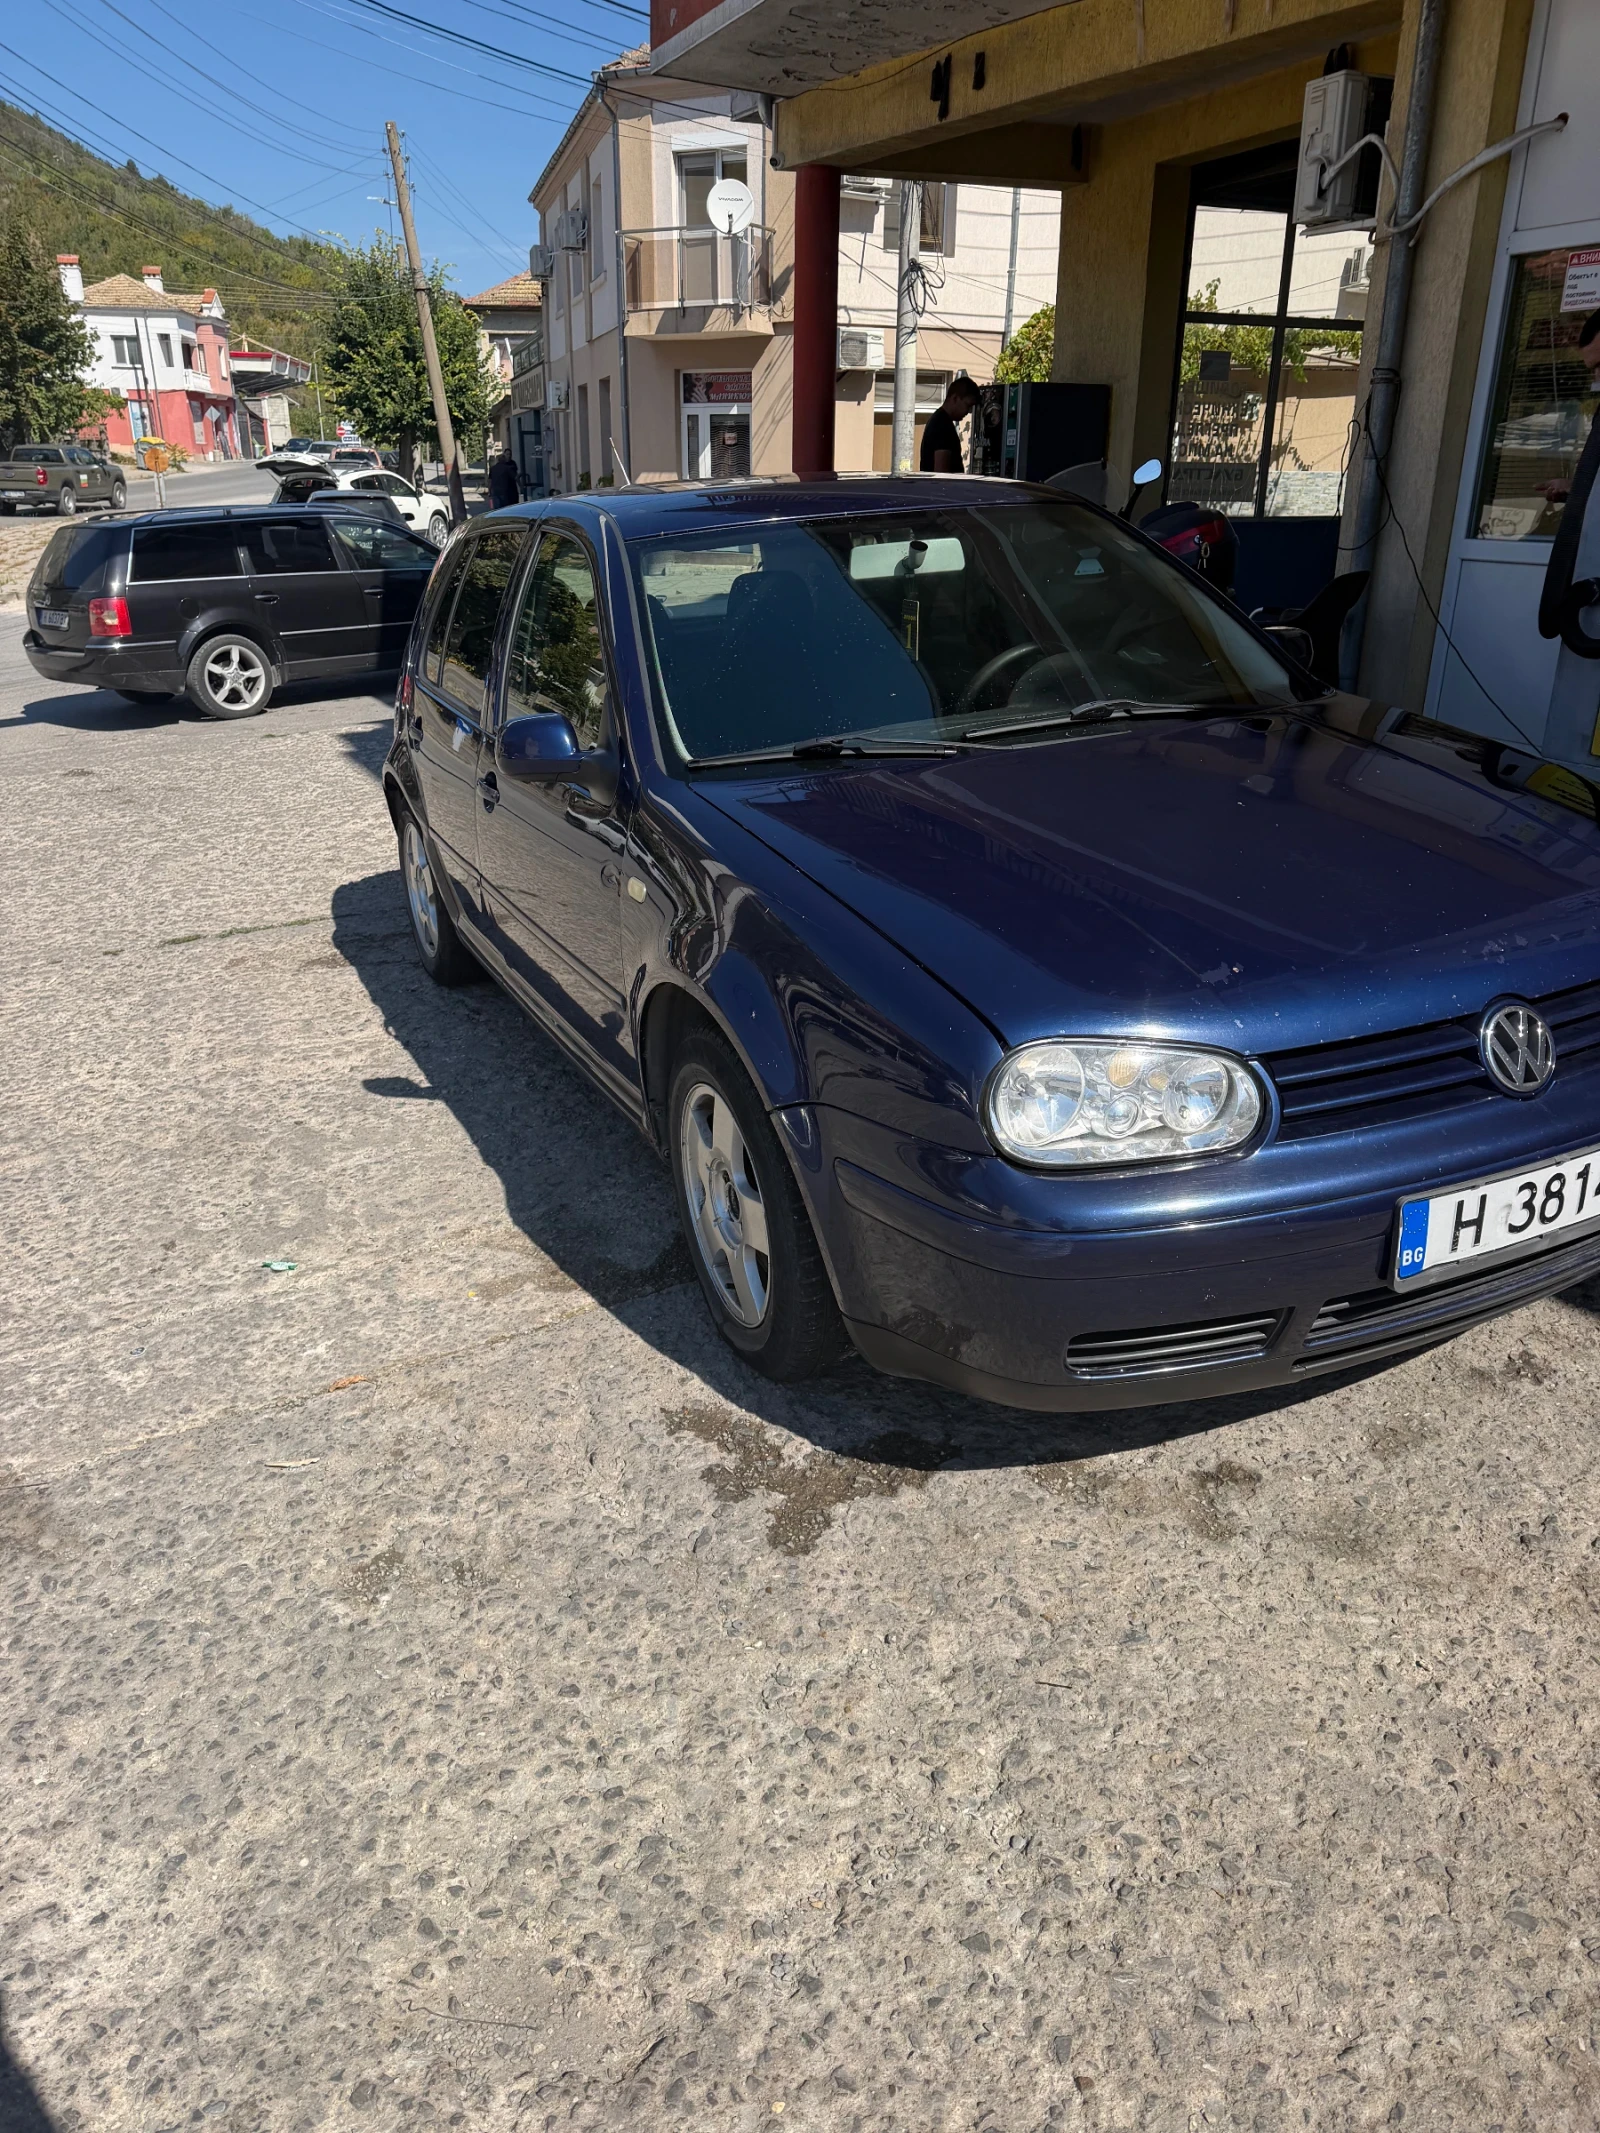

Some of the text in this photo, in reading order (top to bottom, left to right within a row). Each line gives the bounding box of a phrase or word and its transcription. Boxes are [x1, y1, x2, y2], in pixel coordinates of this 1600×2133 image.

[1580, 252, 1600, 264] ВНИ
[709, 392, 752, 401] МАНИКЮР
[1450, 1193, 1488, 1254] H
[1402, 1246, 1424, 1266] BG
